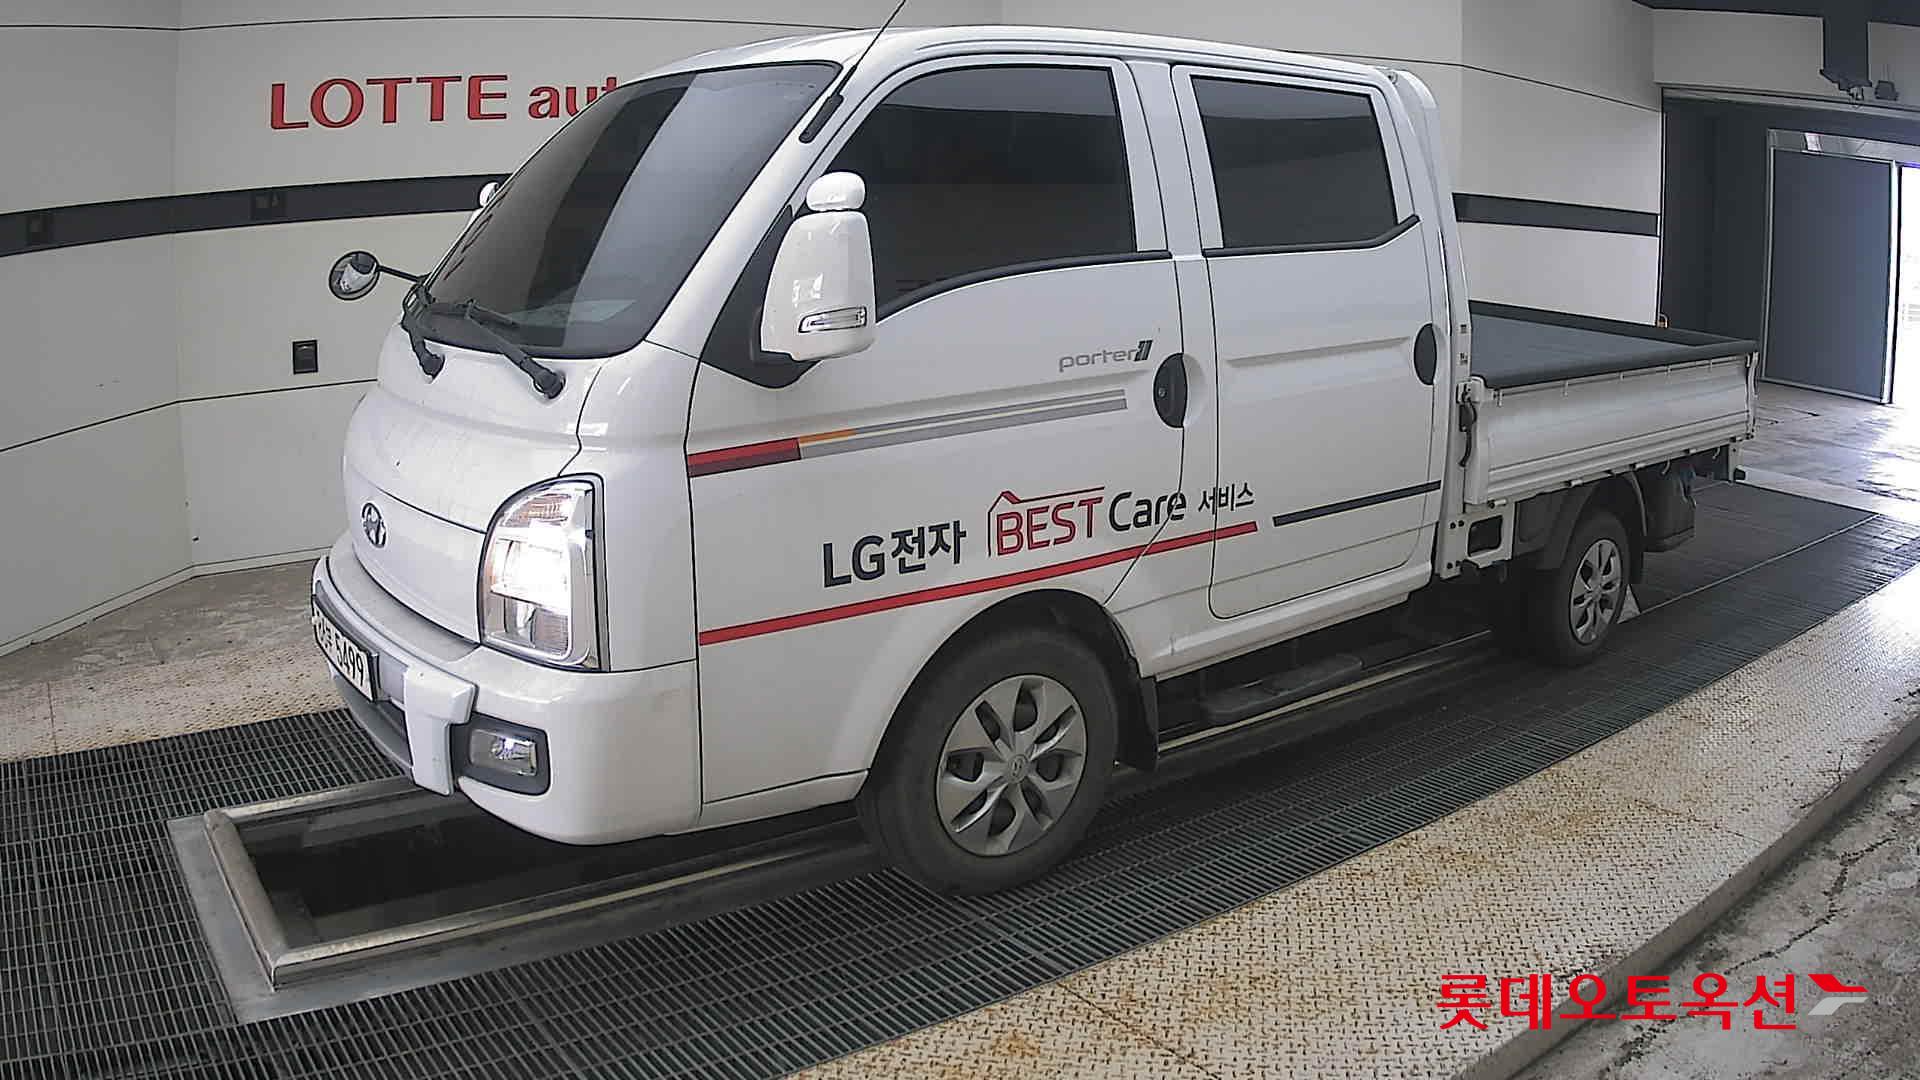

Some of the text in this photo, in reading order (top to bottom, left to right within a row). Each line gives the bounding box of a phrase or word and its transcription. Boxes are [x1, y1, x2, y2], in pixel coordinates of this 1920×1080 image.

[271, 74, 508, 130] LOTTE
[997, 497, 1104, 555] BEST
[1109, 492, 1187, 531] Care
[1198, 483, 1254, 514] 서비스
